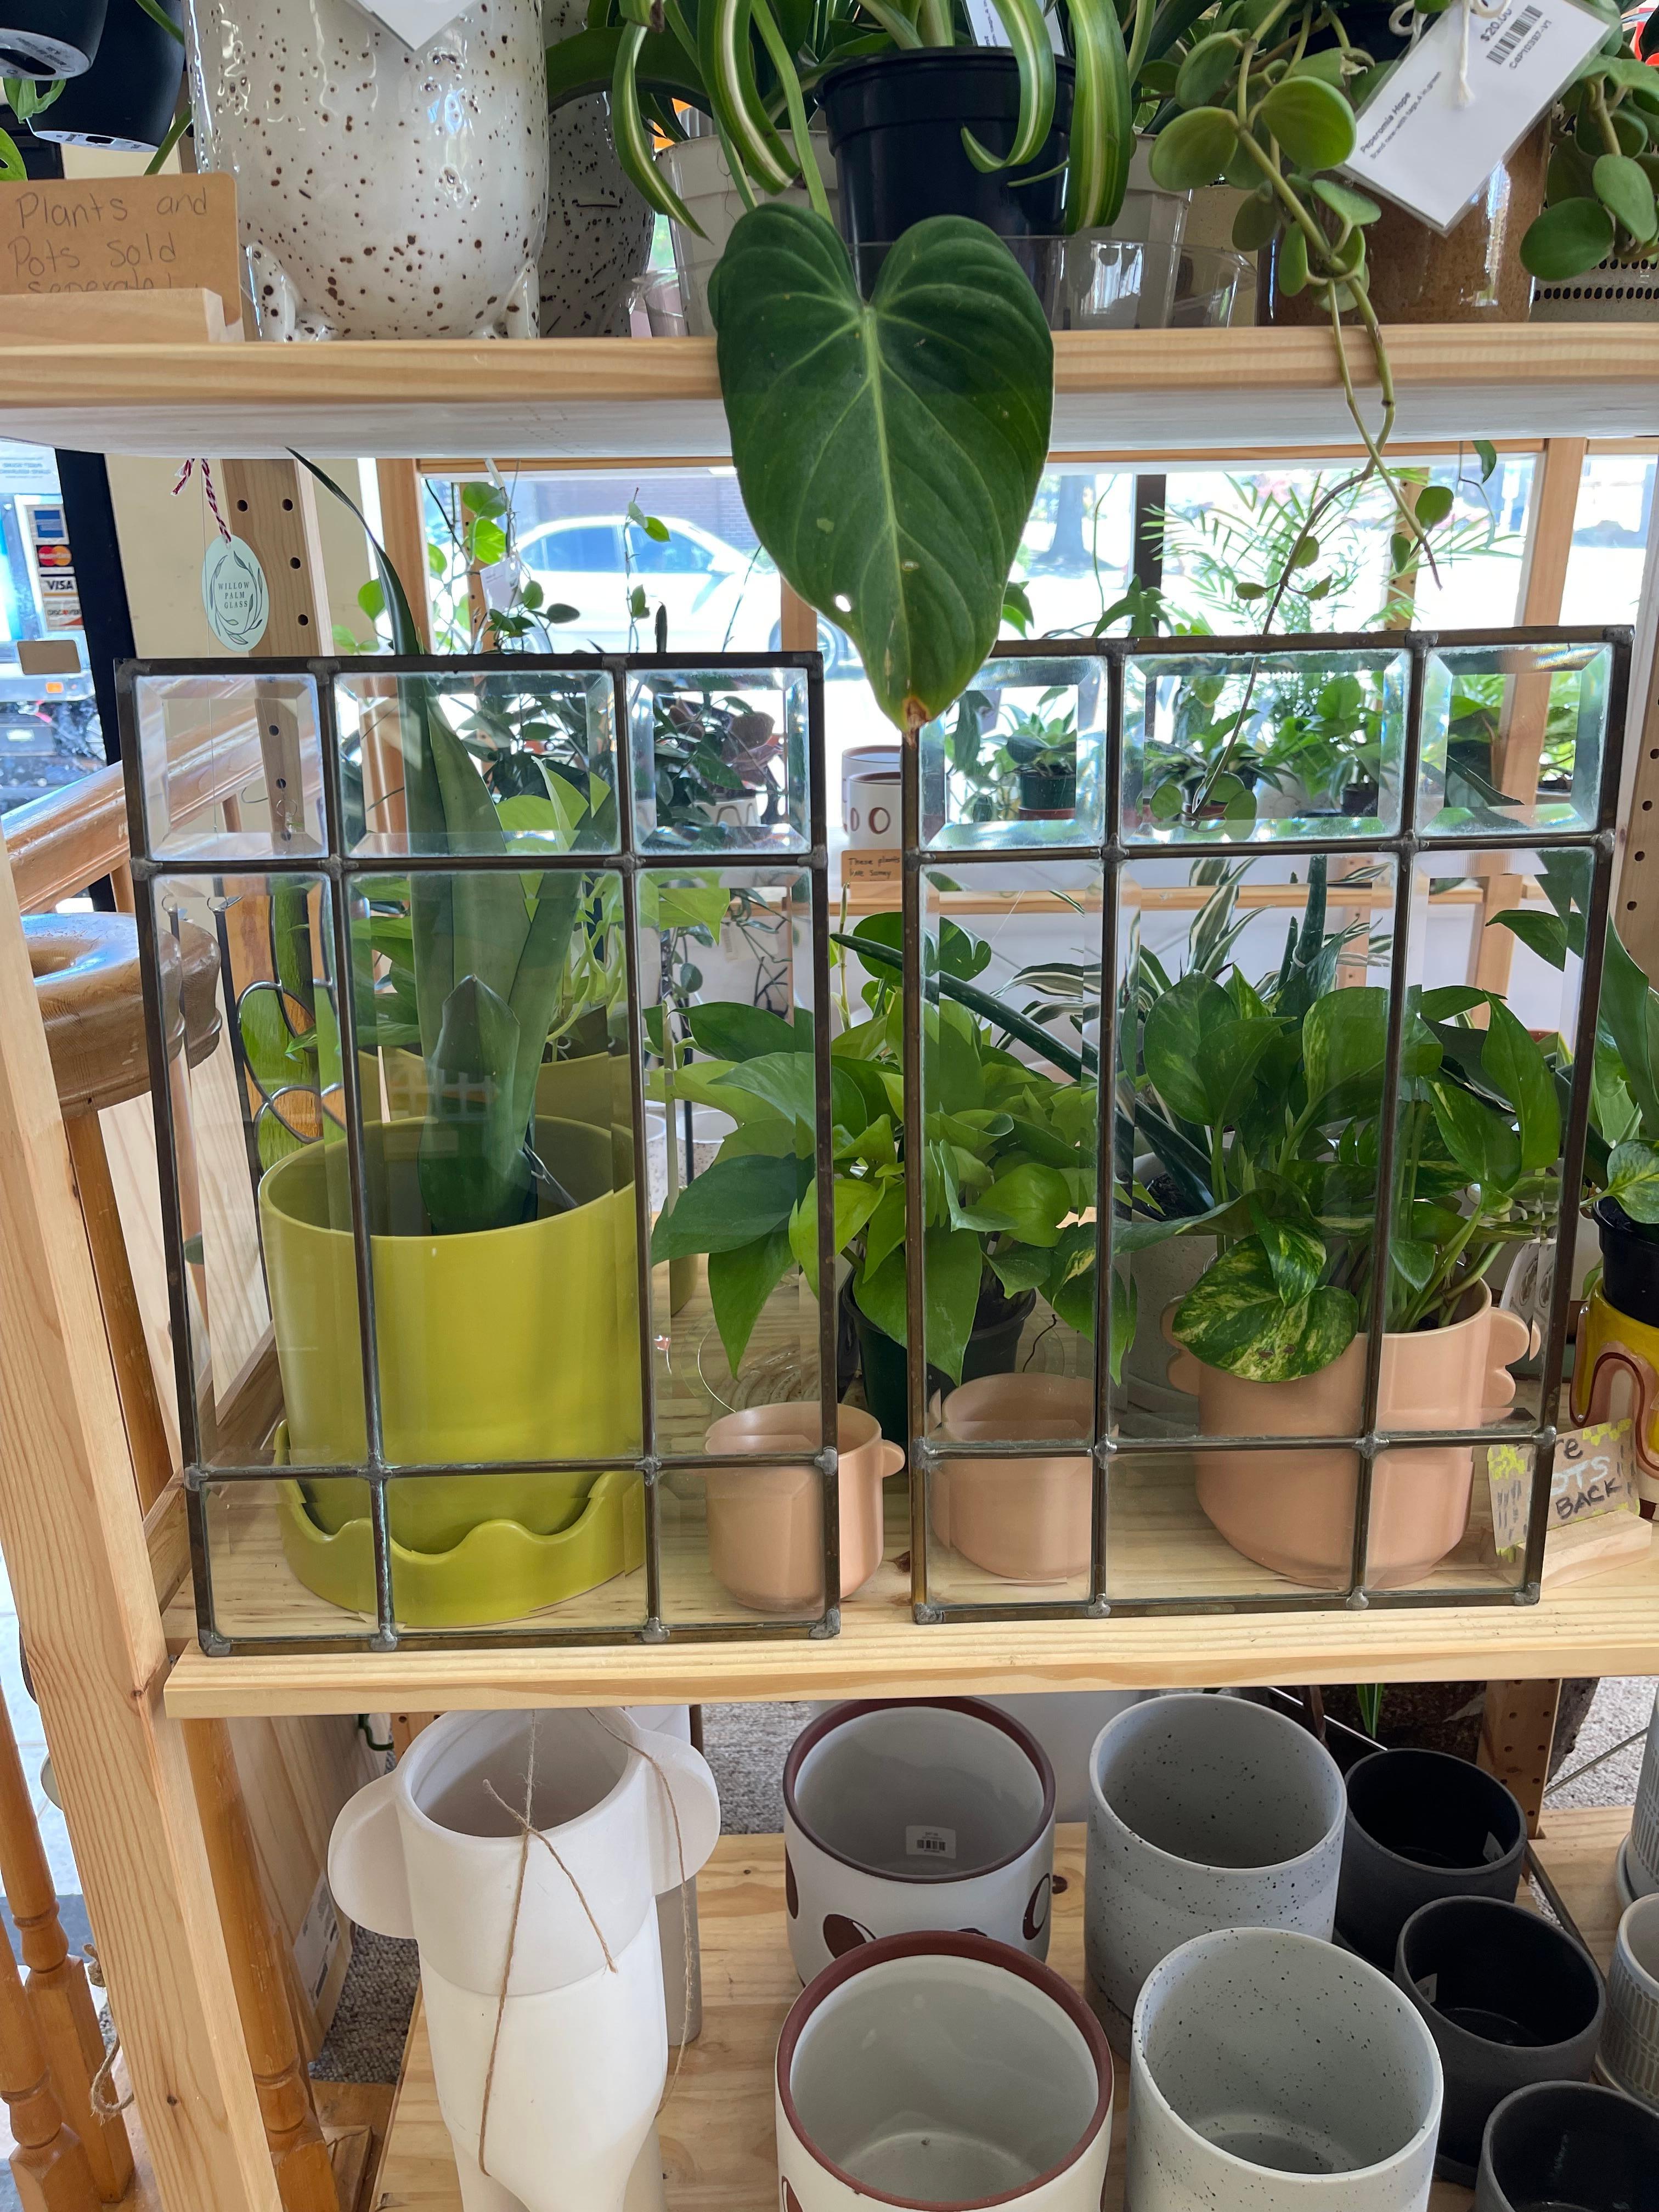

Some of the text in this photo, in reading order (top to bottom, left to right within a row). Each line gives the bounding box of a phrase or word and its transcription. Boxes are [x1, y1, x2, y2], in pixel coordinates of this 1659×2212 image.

[1480, 8, 1512, 42] $20.00
[1361, 92, 1410, 154] Peperomia Hope
[15, 187, 207, 229] Plants and
[8, 232, 176, 278] Pots Sold
[46, 580, 74, 590] VISA
[218, 582, 250, 590] WILLOW
[224, 591, 245, 600] PALM
[224, 600, 248, 609] GLASS
[1550, 1455, 1611, 1497] OTS
[1555, 1477, 1622, 1520] BACK
